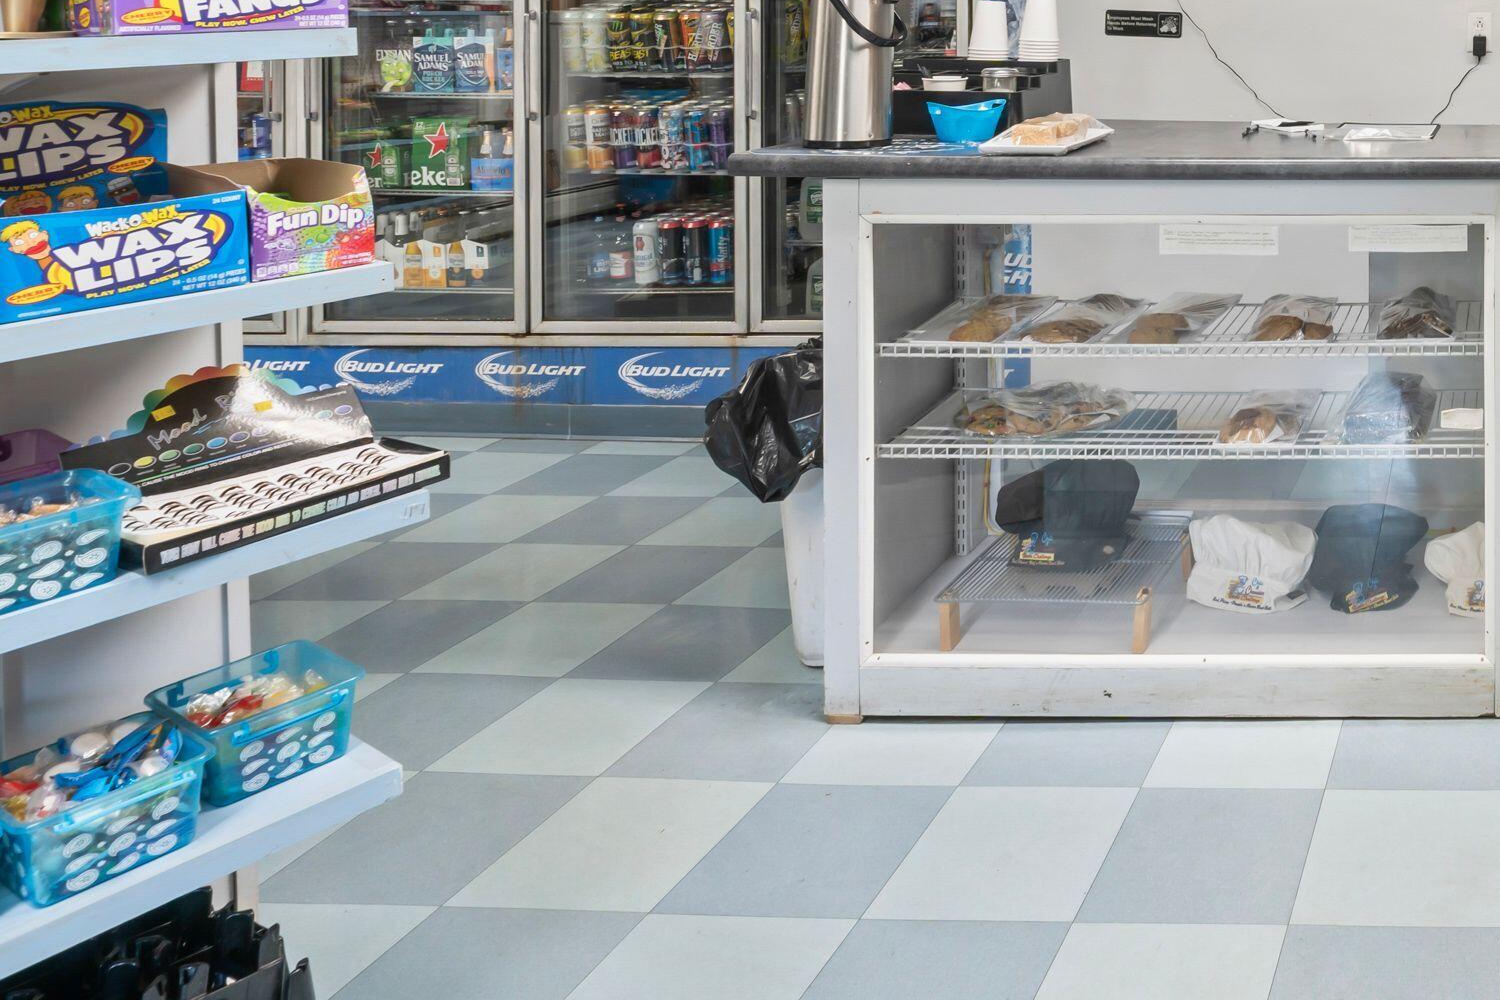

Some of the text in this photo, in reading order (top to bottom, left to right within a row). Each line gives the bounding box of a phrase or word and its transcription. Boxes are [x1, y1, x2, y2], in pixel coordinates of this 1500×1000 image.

[414, 52, 451, 63] SAMUEL
[457, 52, 484, 62] SAMU
[417, 61, 449, 72] ADAMS
[461, 61, 484, 69] ADAM
[267, 203, 364, 237] Fun Dip
[53, 213, 206, 270] WAX
[717, 236, 729, 260] Natty
[73, 237, 213, 293] LIPS
[344, 360, 444, 374] BUD LIGHT
[483, 364, 586, 376] BUD LIGHT
[626, 365, 730, 378] BUD LIGHT
[147, 408, 207, 451] Mood
